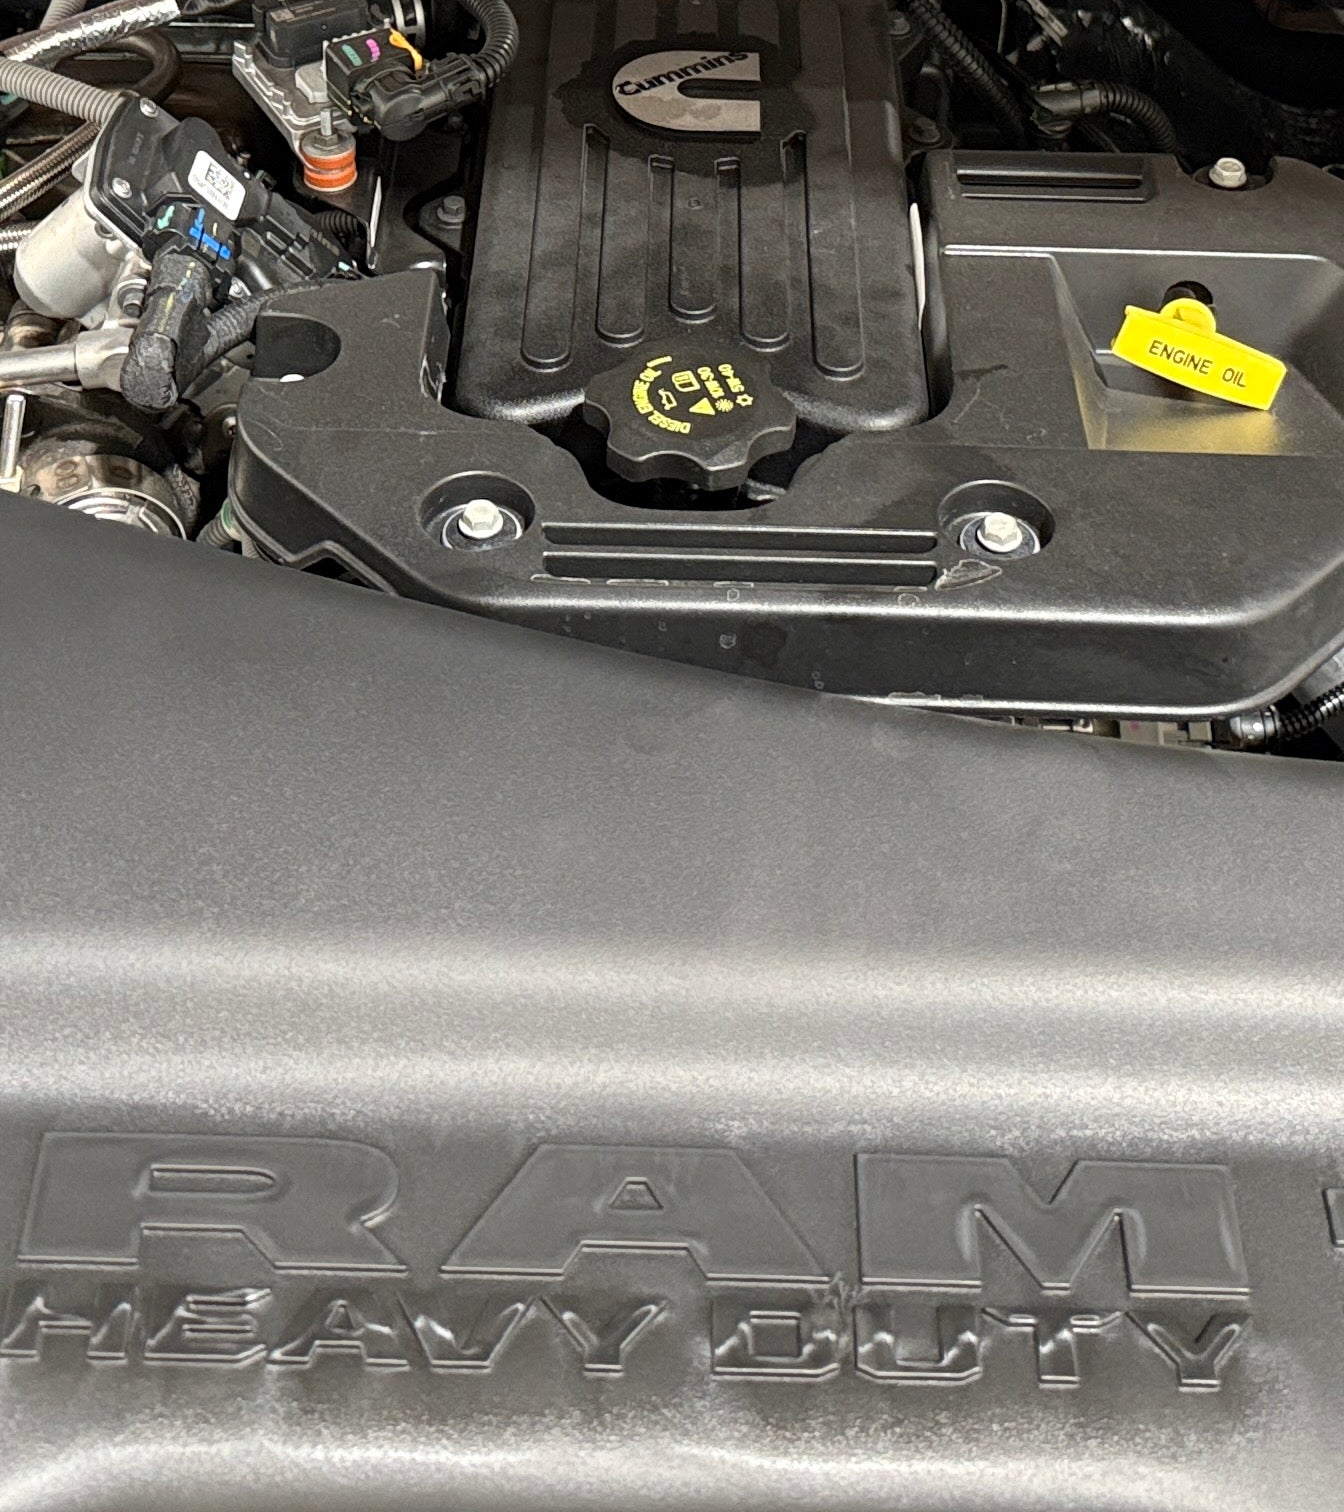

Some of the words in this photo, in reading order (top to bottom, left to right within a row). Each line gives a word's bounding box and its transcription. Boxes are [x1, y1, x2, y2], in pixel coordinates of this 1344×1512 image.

[615, 52, 749, 96] Cummins
[639, 367, 662, 382] OIL
[718, 363, 745, 393] 5W-40
[1149, 340, 1213, 375] ENGINE
[1222, 368, 1246, 388] OIL
[632, 379, 654, 414] ENGINE
[648, 409, 691, 434] DIESEL
[16, 1131, 1253, 1296] RAM
[0, 1286, 667, 1378] HEAVY
[709, 1299, 1250, 1394] DUTY
